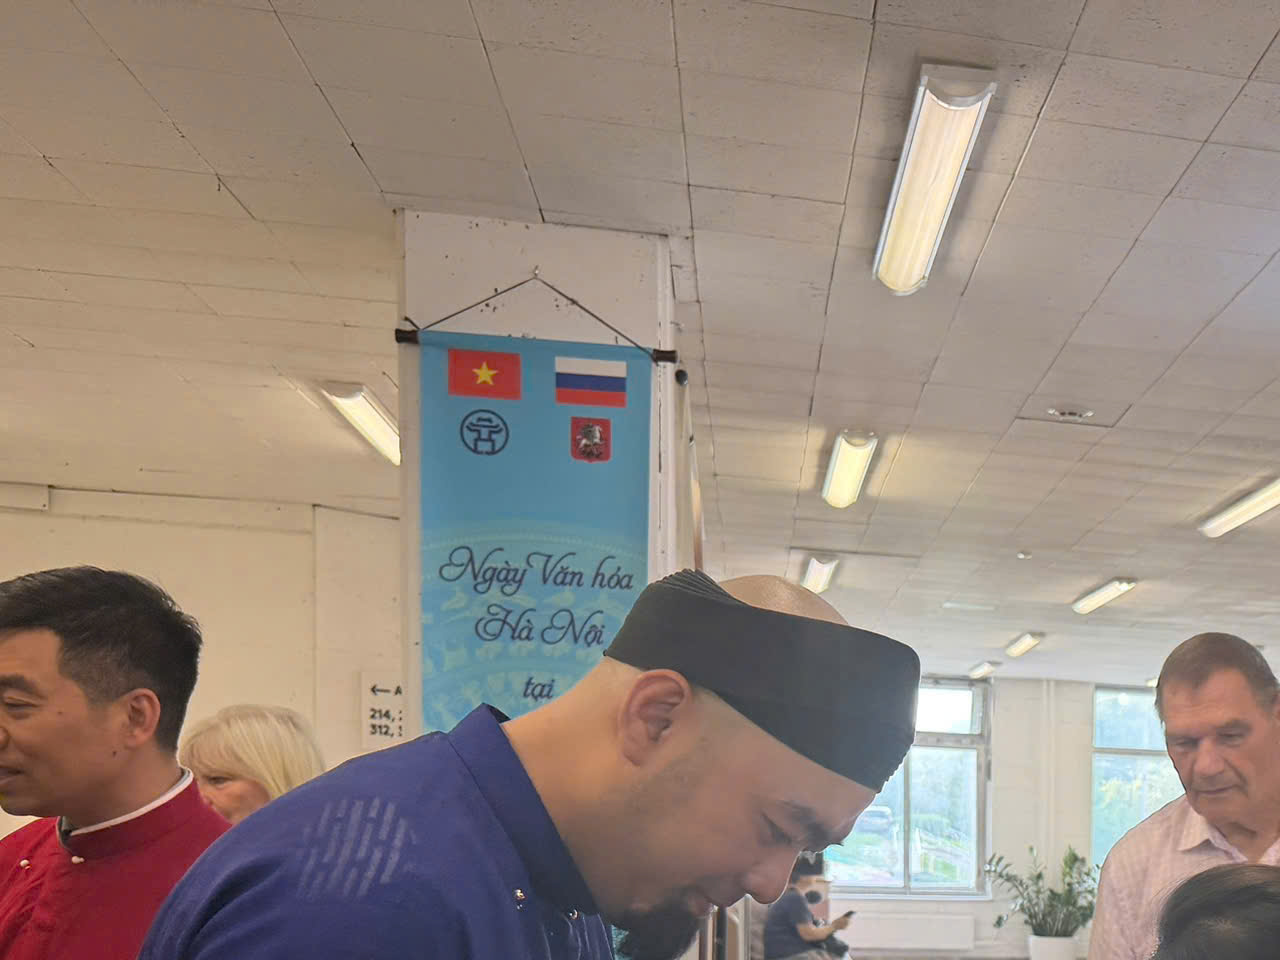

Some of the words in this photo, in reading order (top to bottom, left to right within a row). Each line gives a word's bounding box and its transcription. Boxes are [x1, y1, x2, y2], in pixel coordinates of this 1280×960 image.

[440, 546, 528, 596] Ngày
[527, 552, 584, 587] Văn
[591, 556, 634, 590] hóa
[475, 603, 536, 641] Hà
[541, 608, 606, 647] Nội
[523, 677, 555, 701] tại
